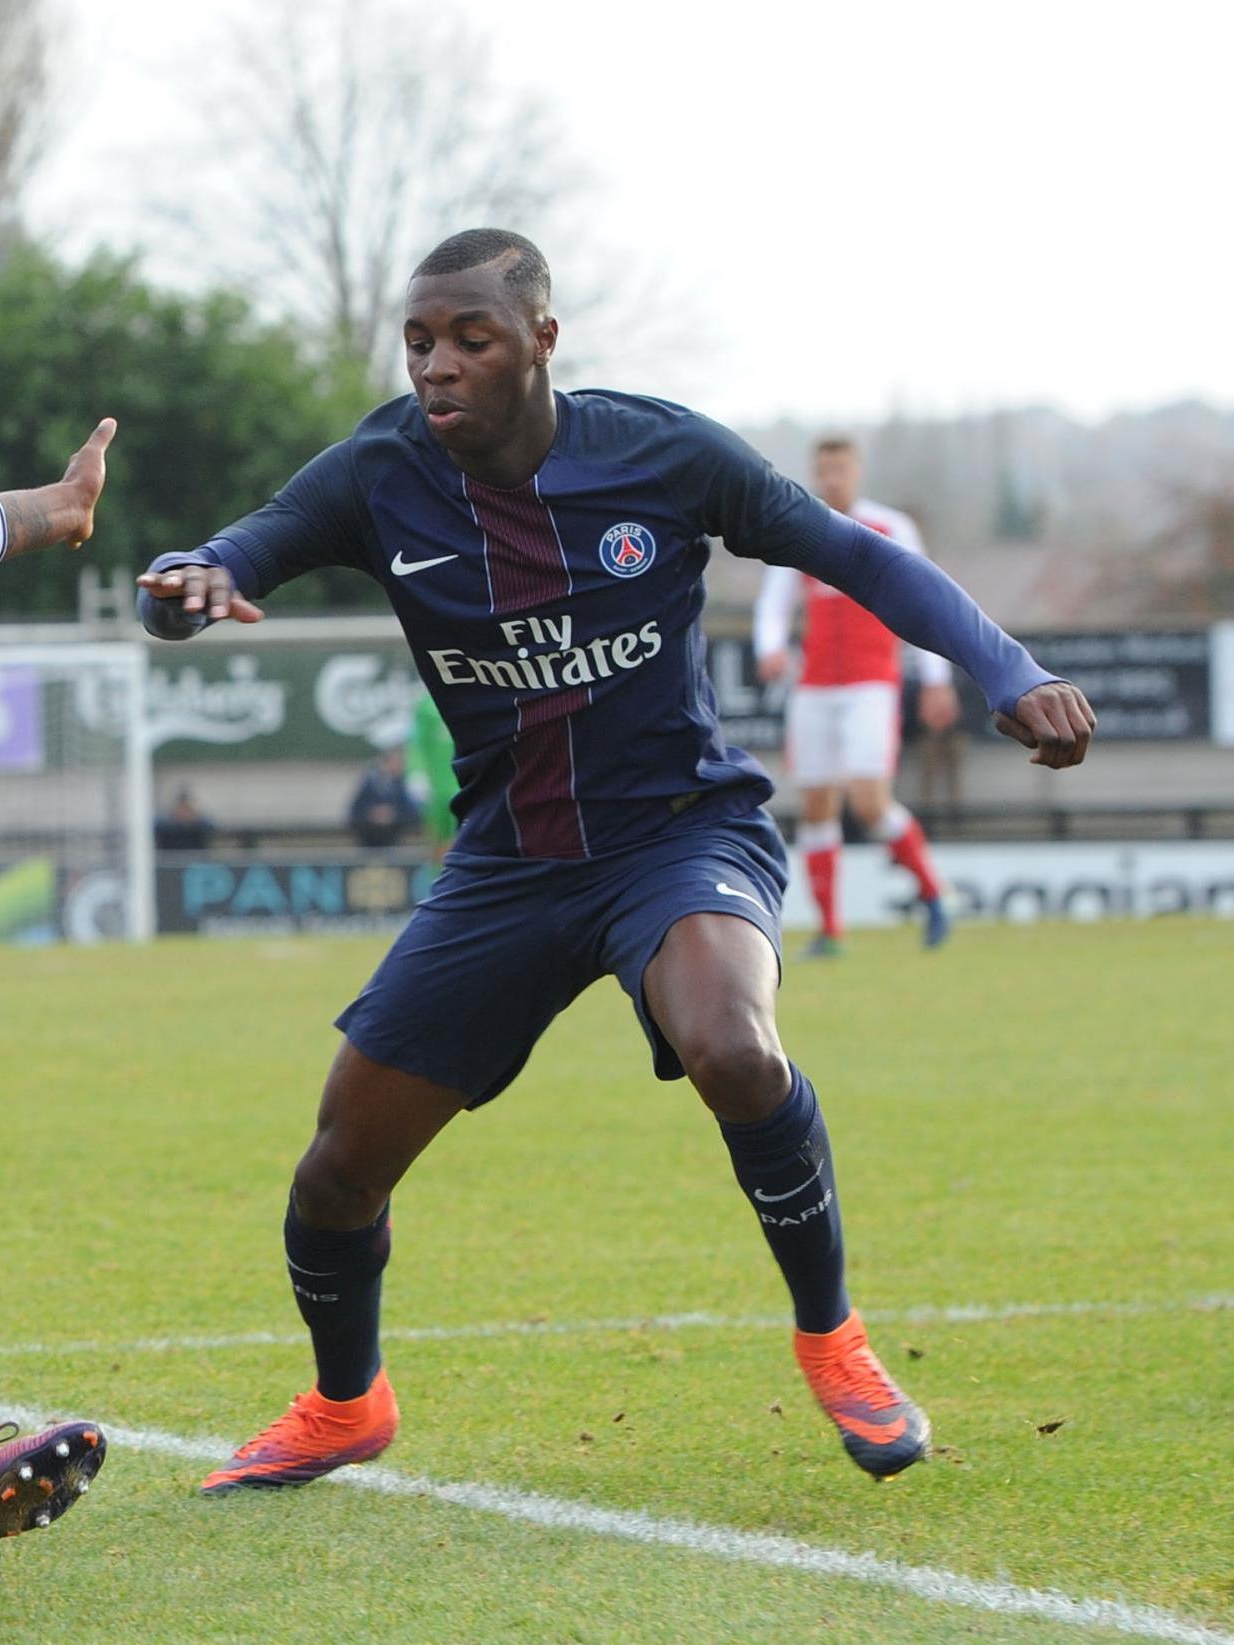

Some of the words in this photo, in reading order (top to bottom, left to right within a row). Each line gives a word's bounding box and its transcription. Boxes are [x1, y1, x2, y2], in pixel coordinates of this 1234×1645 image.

[606, 525, 642, 542] PARIS
[499, 614, 572, 649] Fly
[427, 620, 662, 689] Emirates
[760, 1188, 832, 1227] PARIS
[294, 1285, 340, 1302] RIS
